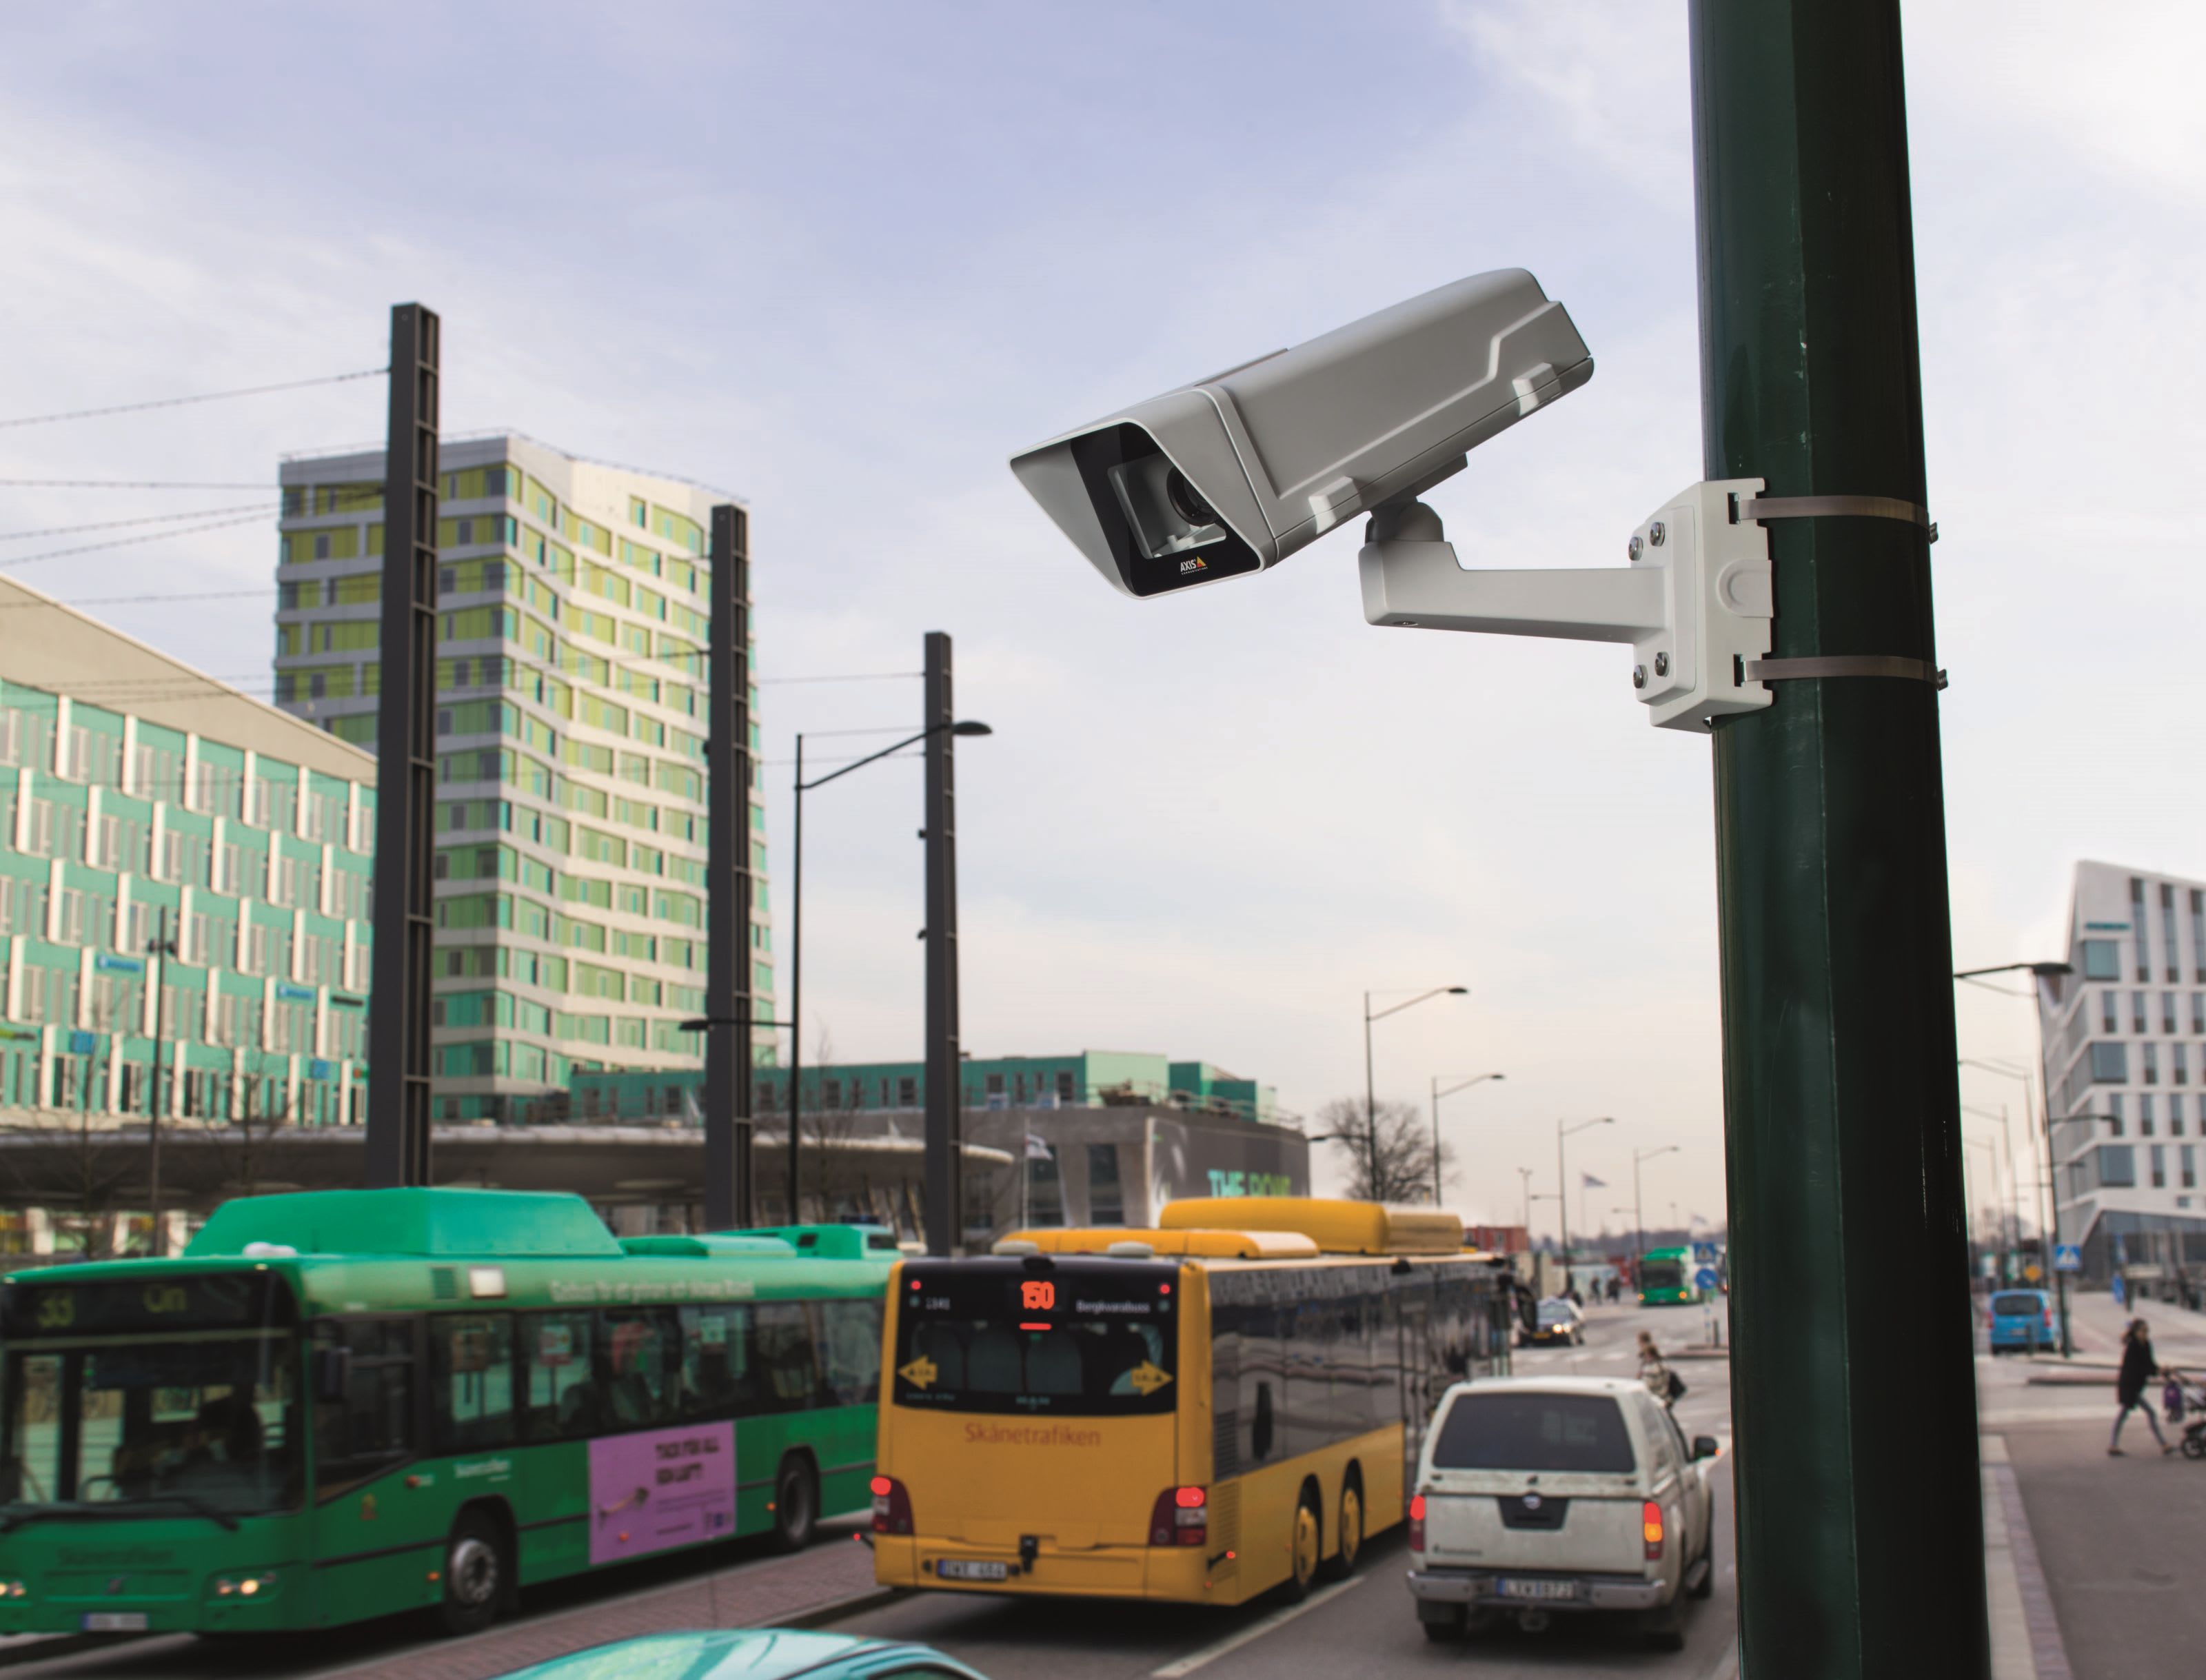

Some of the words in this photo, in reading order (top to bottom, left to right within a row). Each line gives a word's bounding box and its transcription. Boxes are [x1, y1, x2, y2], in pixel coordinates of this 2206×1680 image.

[1180, 559, 1197, 572] AXIS
[1207, 1169, 1245, 1198] THE
[1021, 1281, 1055, 1309] 150
